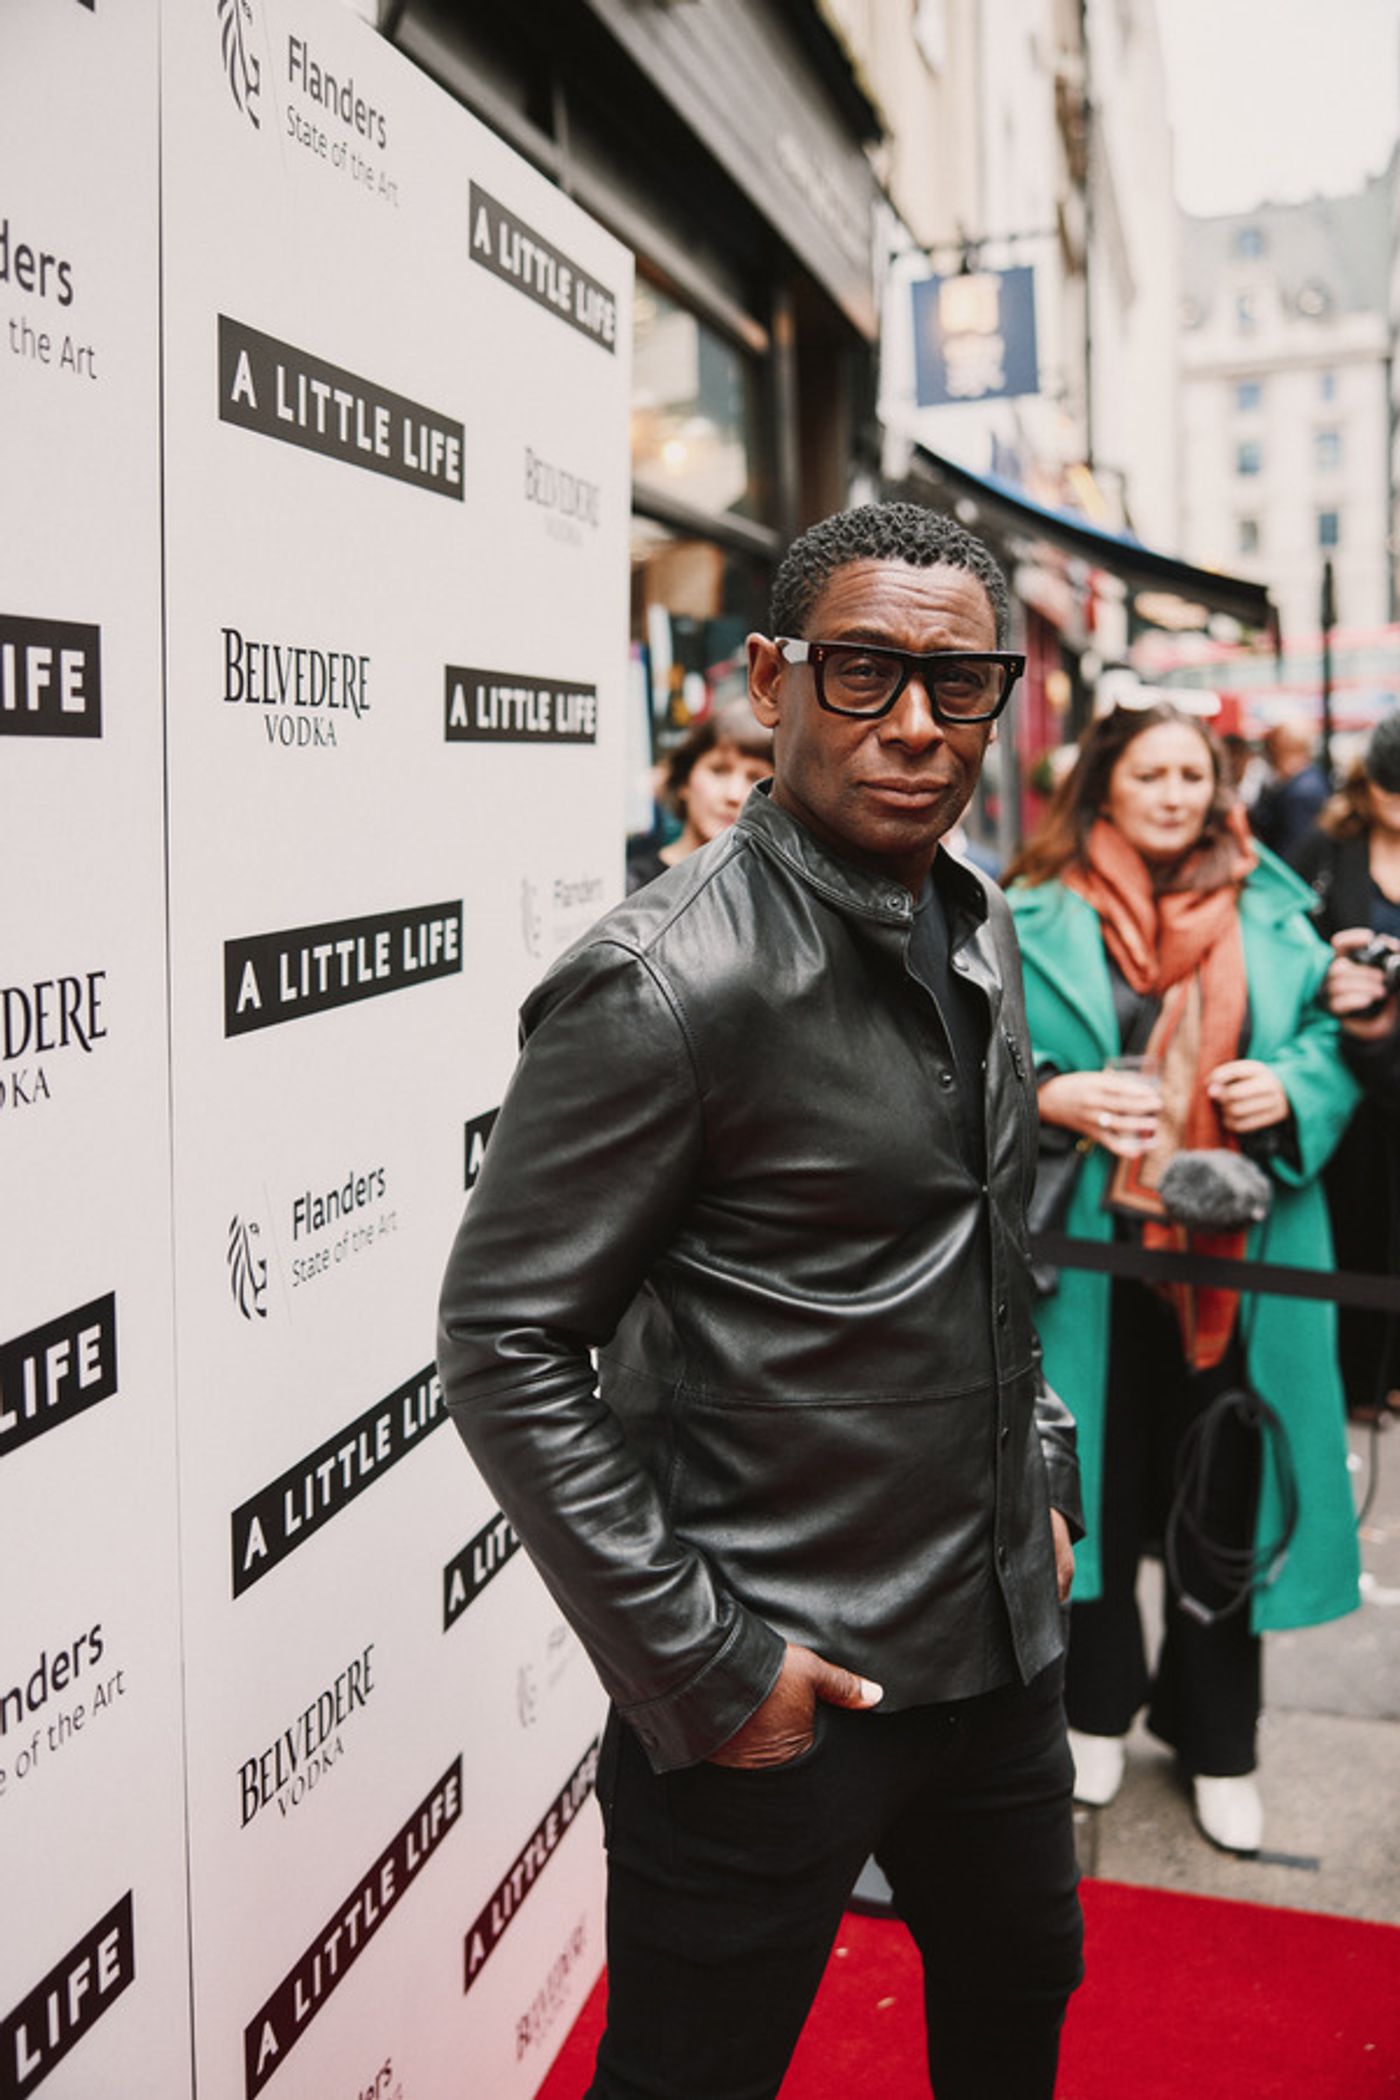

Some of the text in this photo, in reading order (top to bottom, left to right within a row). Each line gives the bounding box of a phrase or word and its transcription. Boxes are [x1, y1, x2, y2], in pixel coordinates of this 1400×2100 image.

[287, 104, 327, 159] State
[289, 35, 386, 149] Flanders
[473, 205, 615, 343] A LITTLE LIFE
[9, 315, 97, 380] the Art
[231, 350, 461, 484] A LITTLE LIFE
[221, 627, 371, 720] BELVEDERE
[449, 683, 595, 734] A LITTLE LIFE
[264, 713, 337, 747] VODKA
[236, 917, 459, 1014] A LITTLE LIFE
[0, 971, 107, 1060] DERE
[469, 1131, 485, 1174] A
[293, 1167, 386, 1241] Flanders
[292, 1248, 330, 1287] State
[243, 1374, 443, 1572] A LITTLE LIF
[448, 1519, 519, 1613] A LIT
[16, 1670, 125, 1779] of the Art
[238, 1642, 375, 1830] BELVEDERE
[277, 1736, 344, 1818] VODKA
[256, 1774, 458, 2076] A LITTLE LIFE
[469, 1932, 485, 1975] A
[492, 1811, 558, 1936] LITTLE
[16, 1925, 120, 2084] LIFE
